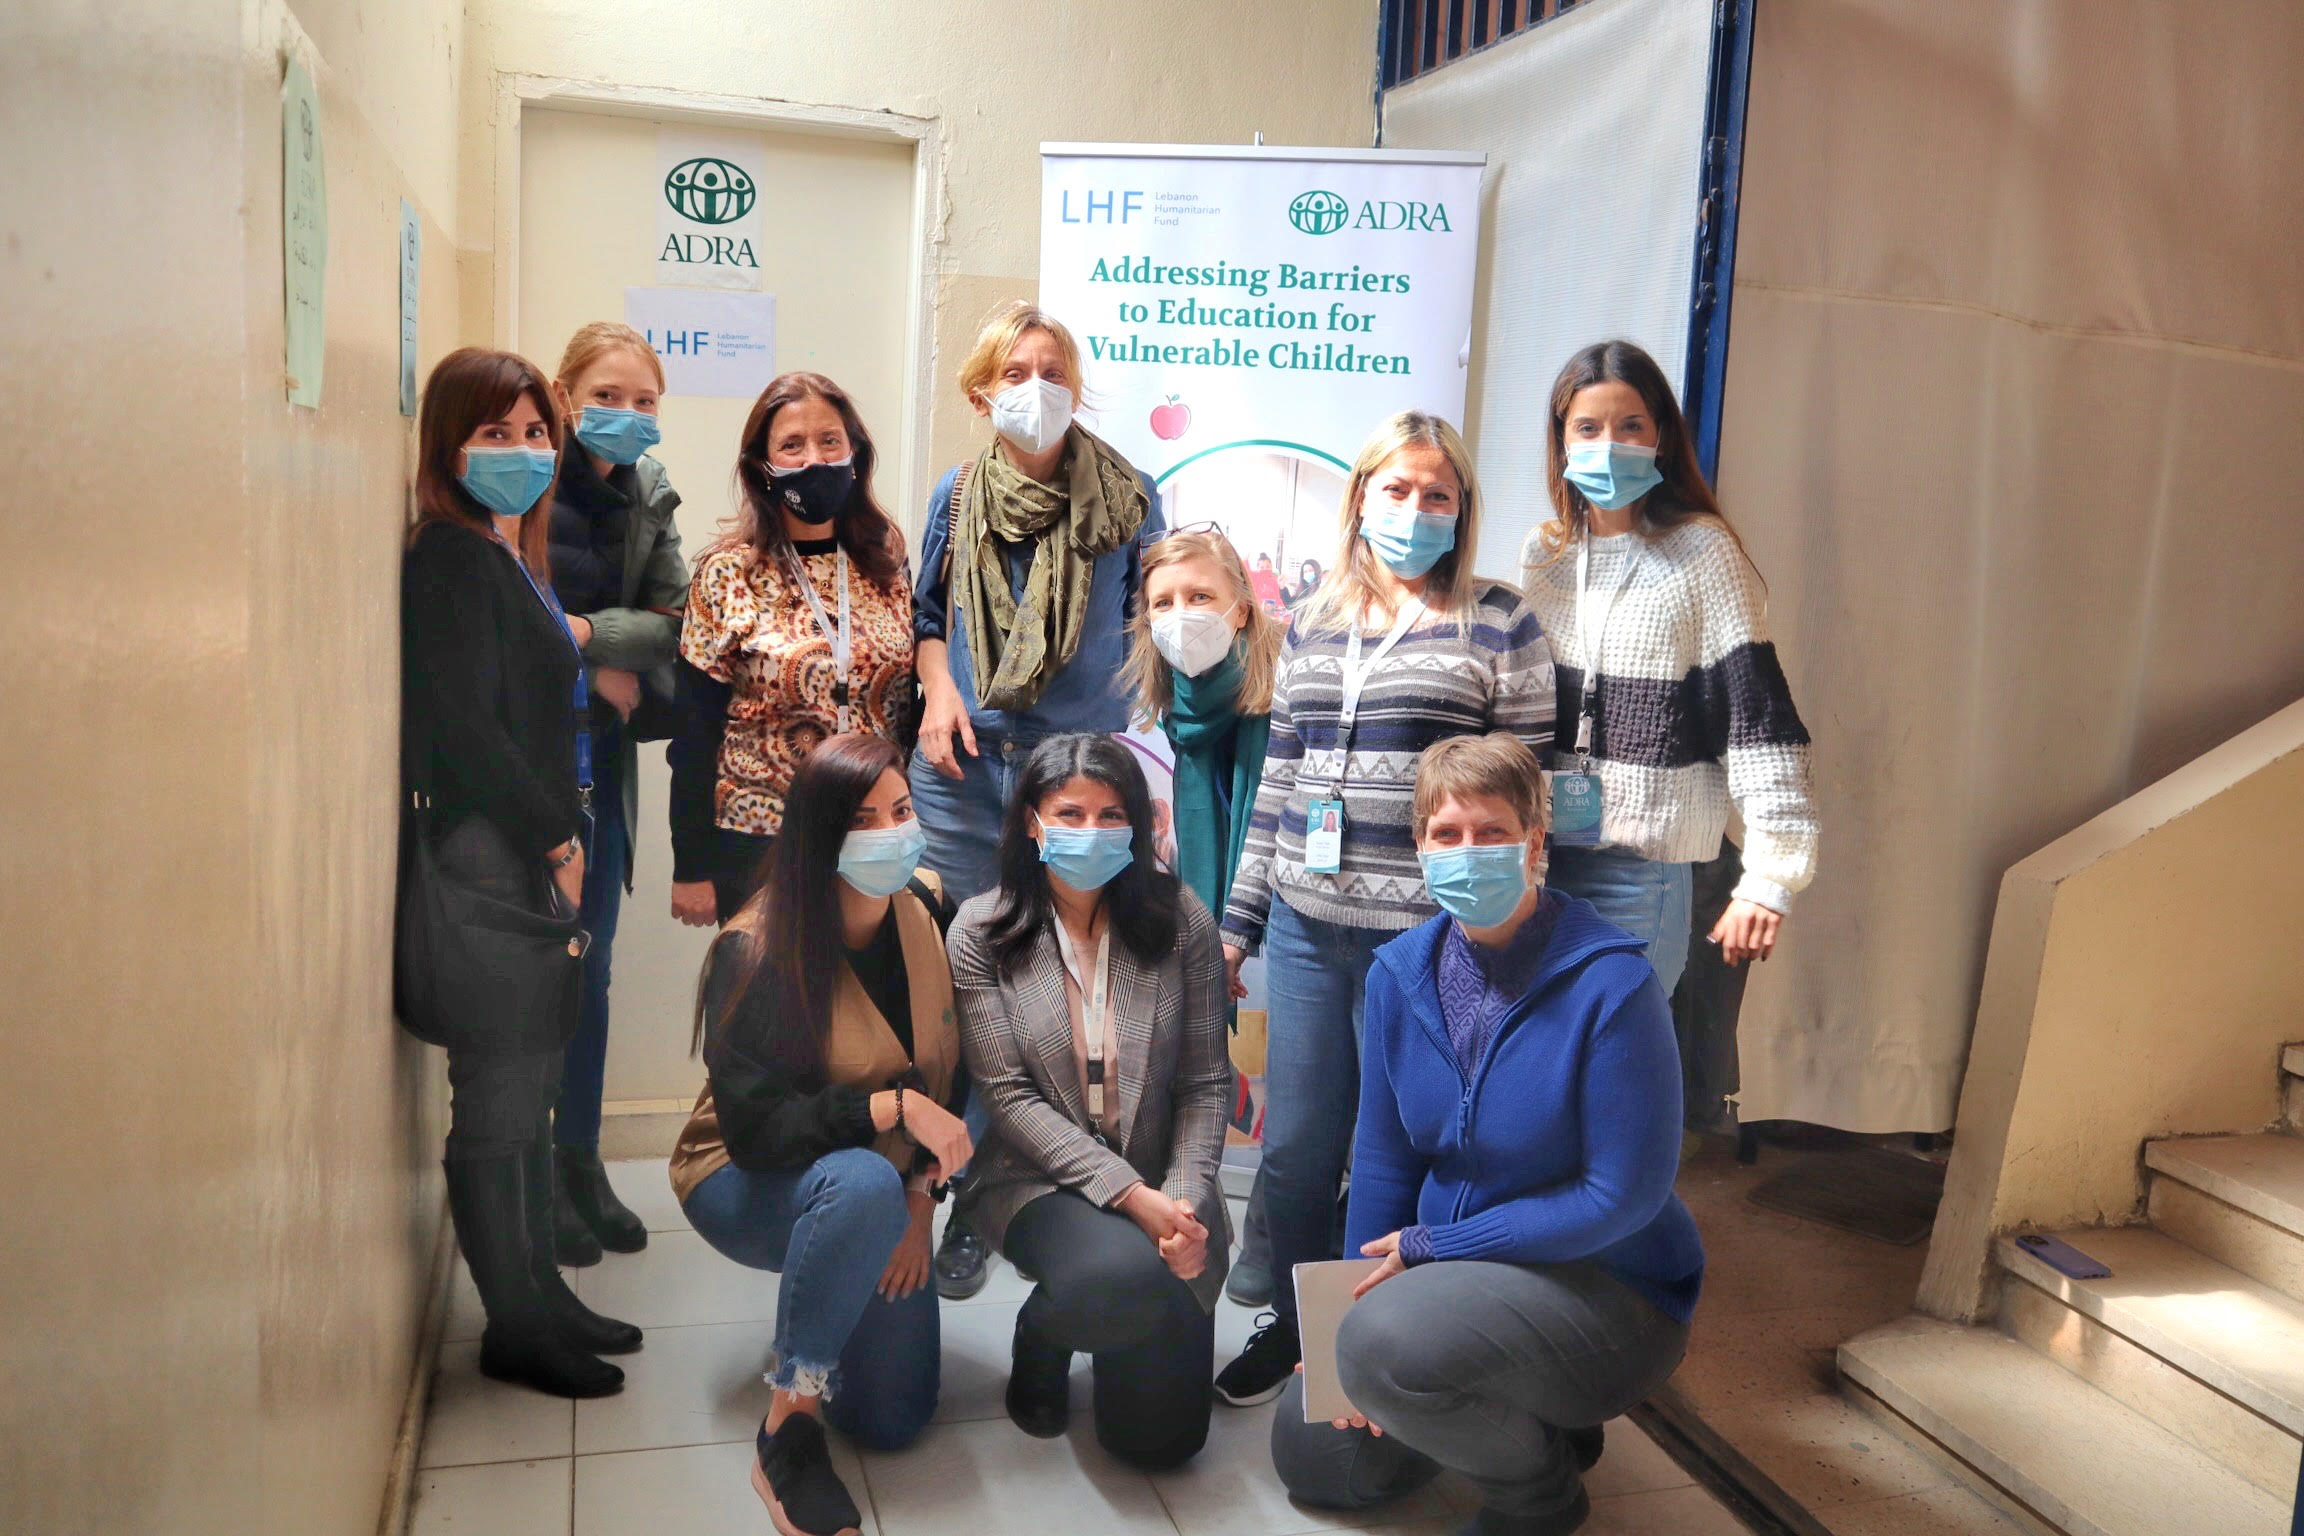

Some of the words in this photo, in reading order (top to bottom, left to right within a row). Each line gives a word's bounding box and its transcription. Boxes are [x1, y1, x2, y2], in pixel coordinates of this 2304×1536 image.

[1154, 191, 1199, 202] Lebanon
[1061, 189, 1145, 225] LHF
[1153, 203, 1222, 216] Humanitarian
[1153, 216, 1180, 227] Fund
[1353, 200, 1454, 233] ADRA
[658, 232, 761, 268] ADRA
[1088, 255, 1271, 297] Addressing
[1276, 263, 1412, 294] Barriers
[1118, 301, 1149, 323] to
[1156, 297, 1319, 331] Education
[1326, 302, 1377, 333] for
[716, 332, 750, 341] Lebanon
[716, 341, 767, 351] Humanitarian
[716, 350, 737, 358] Fund
[1086, 334, 1260, 368] Vulnerable
[1267, 341, 1412, 375] Children
[1562, 796, 1591, 807] ADRA
